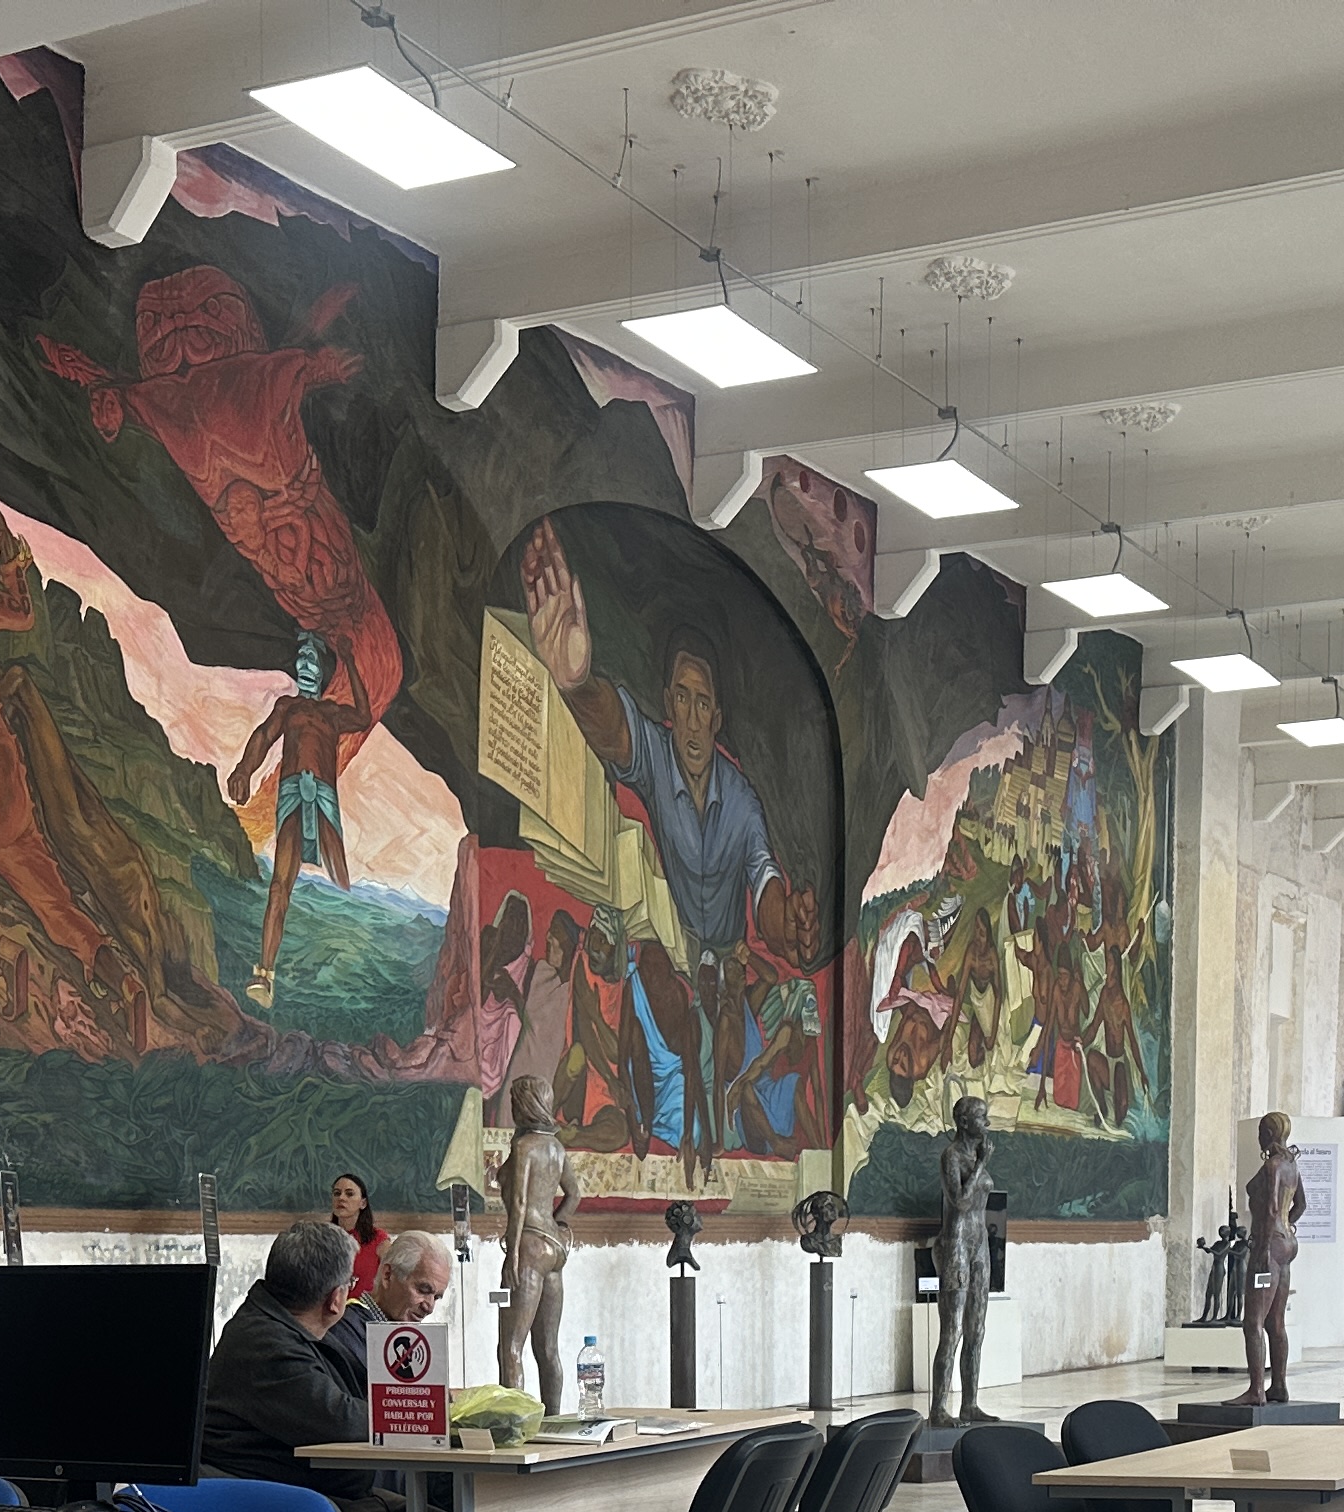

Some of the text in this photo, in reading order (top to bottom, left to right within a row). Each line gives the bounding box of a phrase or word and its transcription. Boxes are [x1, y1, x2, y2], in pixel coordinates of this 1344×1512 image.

[385, 1386, 431, 1396] PROHIBIDO
[382, 1398, 436, 1408] CONVERSAR Y
[384, 1411, 434, 1420] HABLAR POR
[389, 1422, 429, 1433] TELÉFONO
